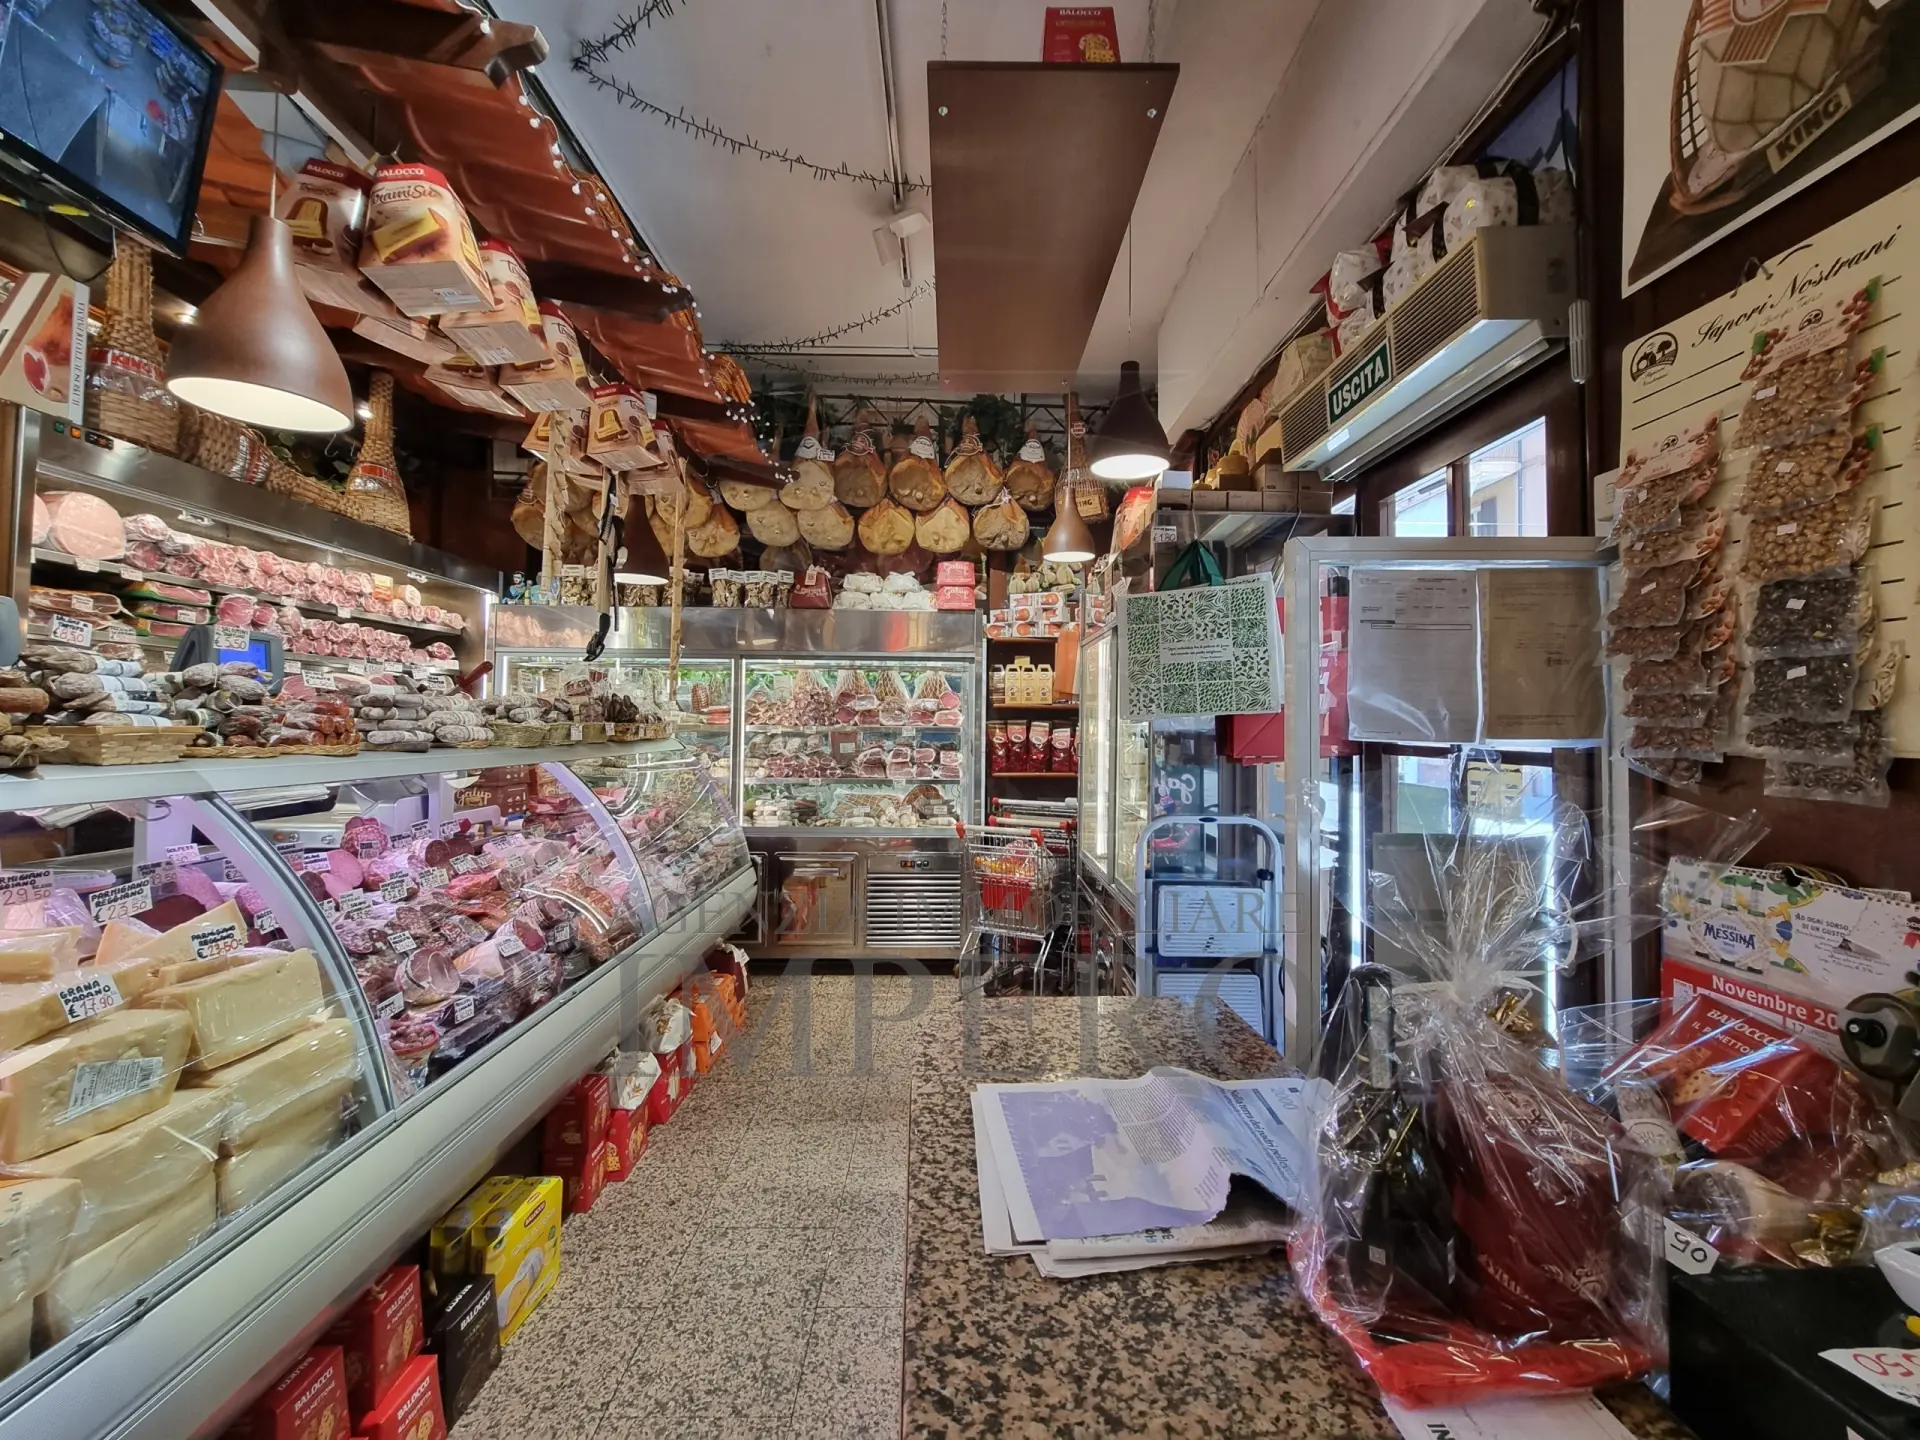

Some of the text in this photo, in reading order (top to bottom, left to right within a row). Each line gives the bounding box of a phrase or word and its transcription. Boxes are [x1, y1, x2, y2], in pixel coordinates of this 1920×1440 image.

[1775, 94, 1844, 161] KING
[307, 165, 344, 178] BALOCCO
[377, 168, 424, 177] BALOCCO
[1691, 294, 1772, 348] Sapori
[1769, 225, 1902, 309] Nostrani
[1333, 355, 1384, 415] USCITA
[91, 879, 149, 902] PARMIGIANO
[95, 888, 144, 907] REGGIANO
[191, 925, 236, 941] PARMIGIANO
[1807, 917, 1823, 925] OGNI
[199, 933, 235, 946] REGGIANO
[1703, 921, 1756, 950] MESSINA
[59, 980, 101, 999] GRANA
[64, 985, 111, 1006] PADANO
[1712, 975, 1807, 1020] Novembre
[386, 1283, 414, 1318] BALOCCO
[460, 1290, 491, 1331] BALOCCO
[294, 1366, 333, 1413] BALOCCO
[397, 1375, 430, 1420] BALOCCO
